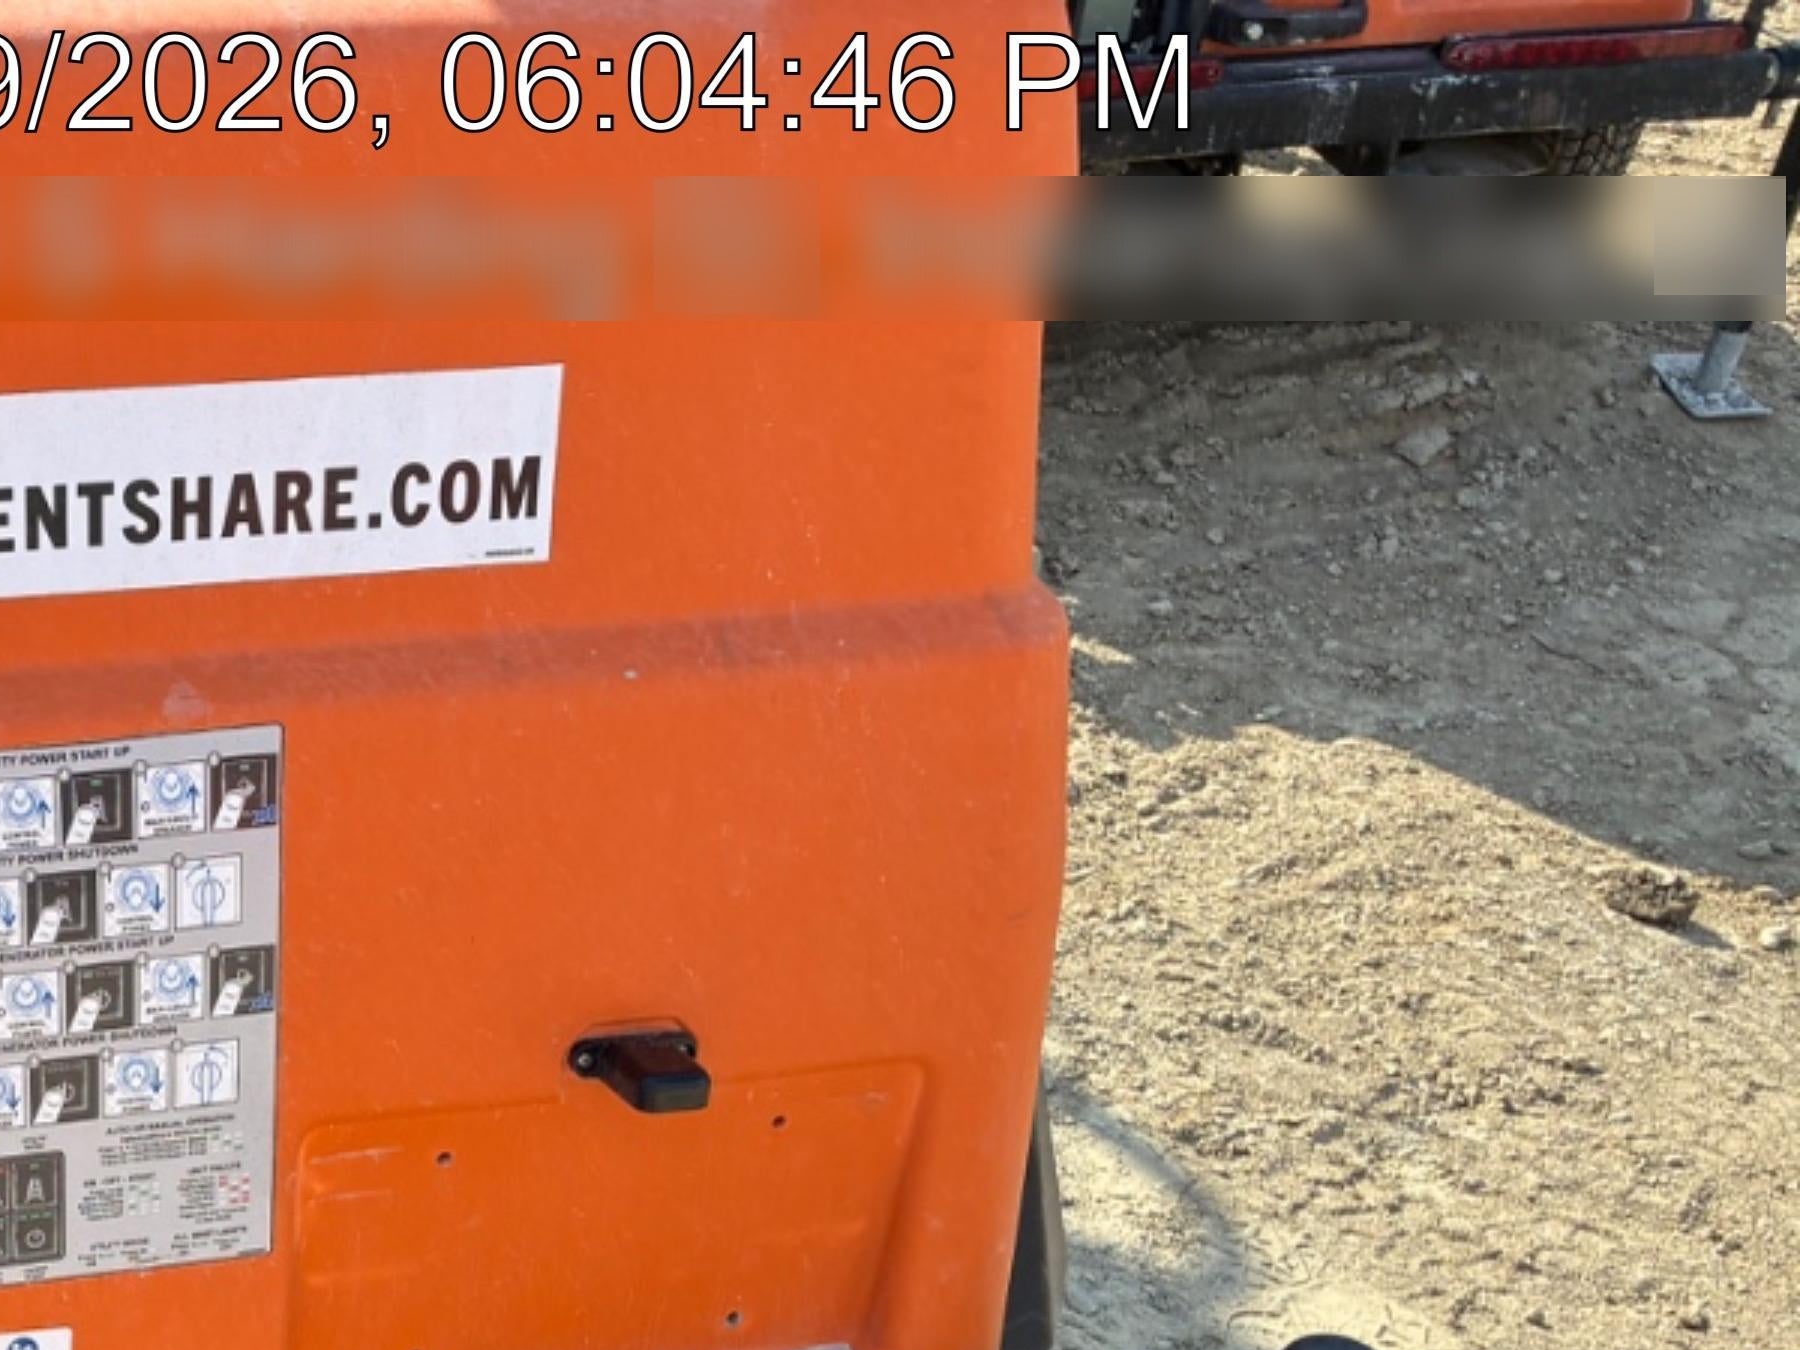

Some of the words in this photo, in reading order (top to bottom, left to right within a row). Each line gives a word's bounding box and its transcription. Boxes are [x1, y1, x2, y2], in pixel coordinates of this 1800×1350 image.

[20, 751, 67, 768] POWER
[70, 748, 109, 763] START
[113, 745, 131, 758] UP
[18, 849, 64, 866] POWER
[67, 843, 139, 861] SHUTDOWN
